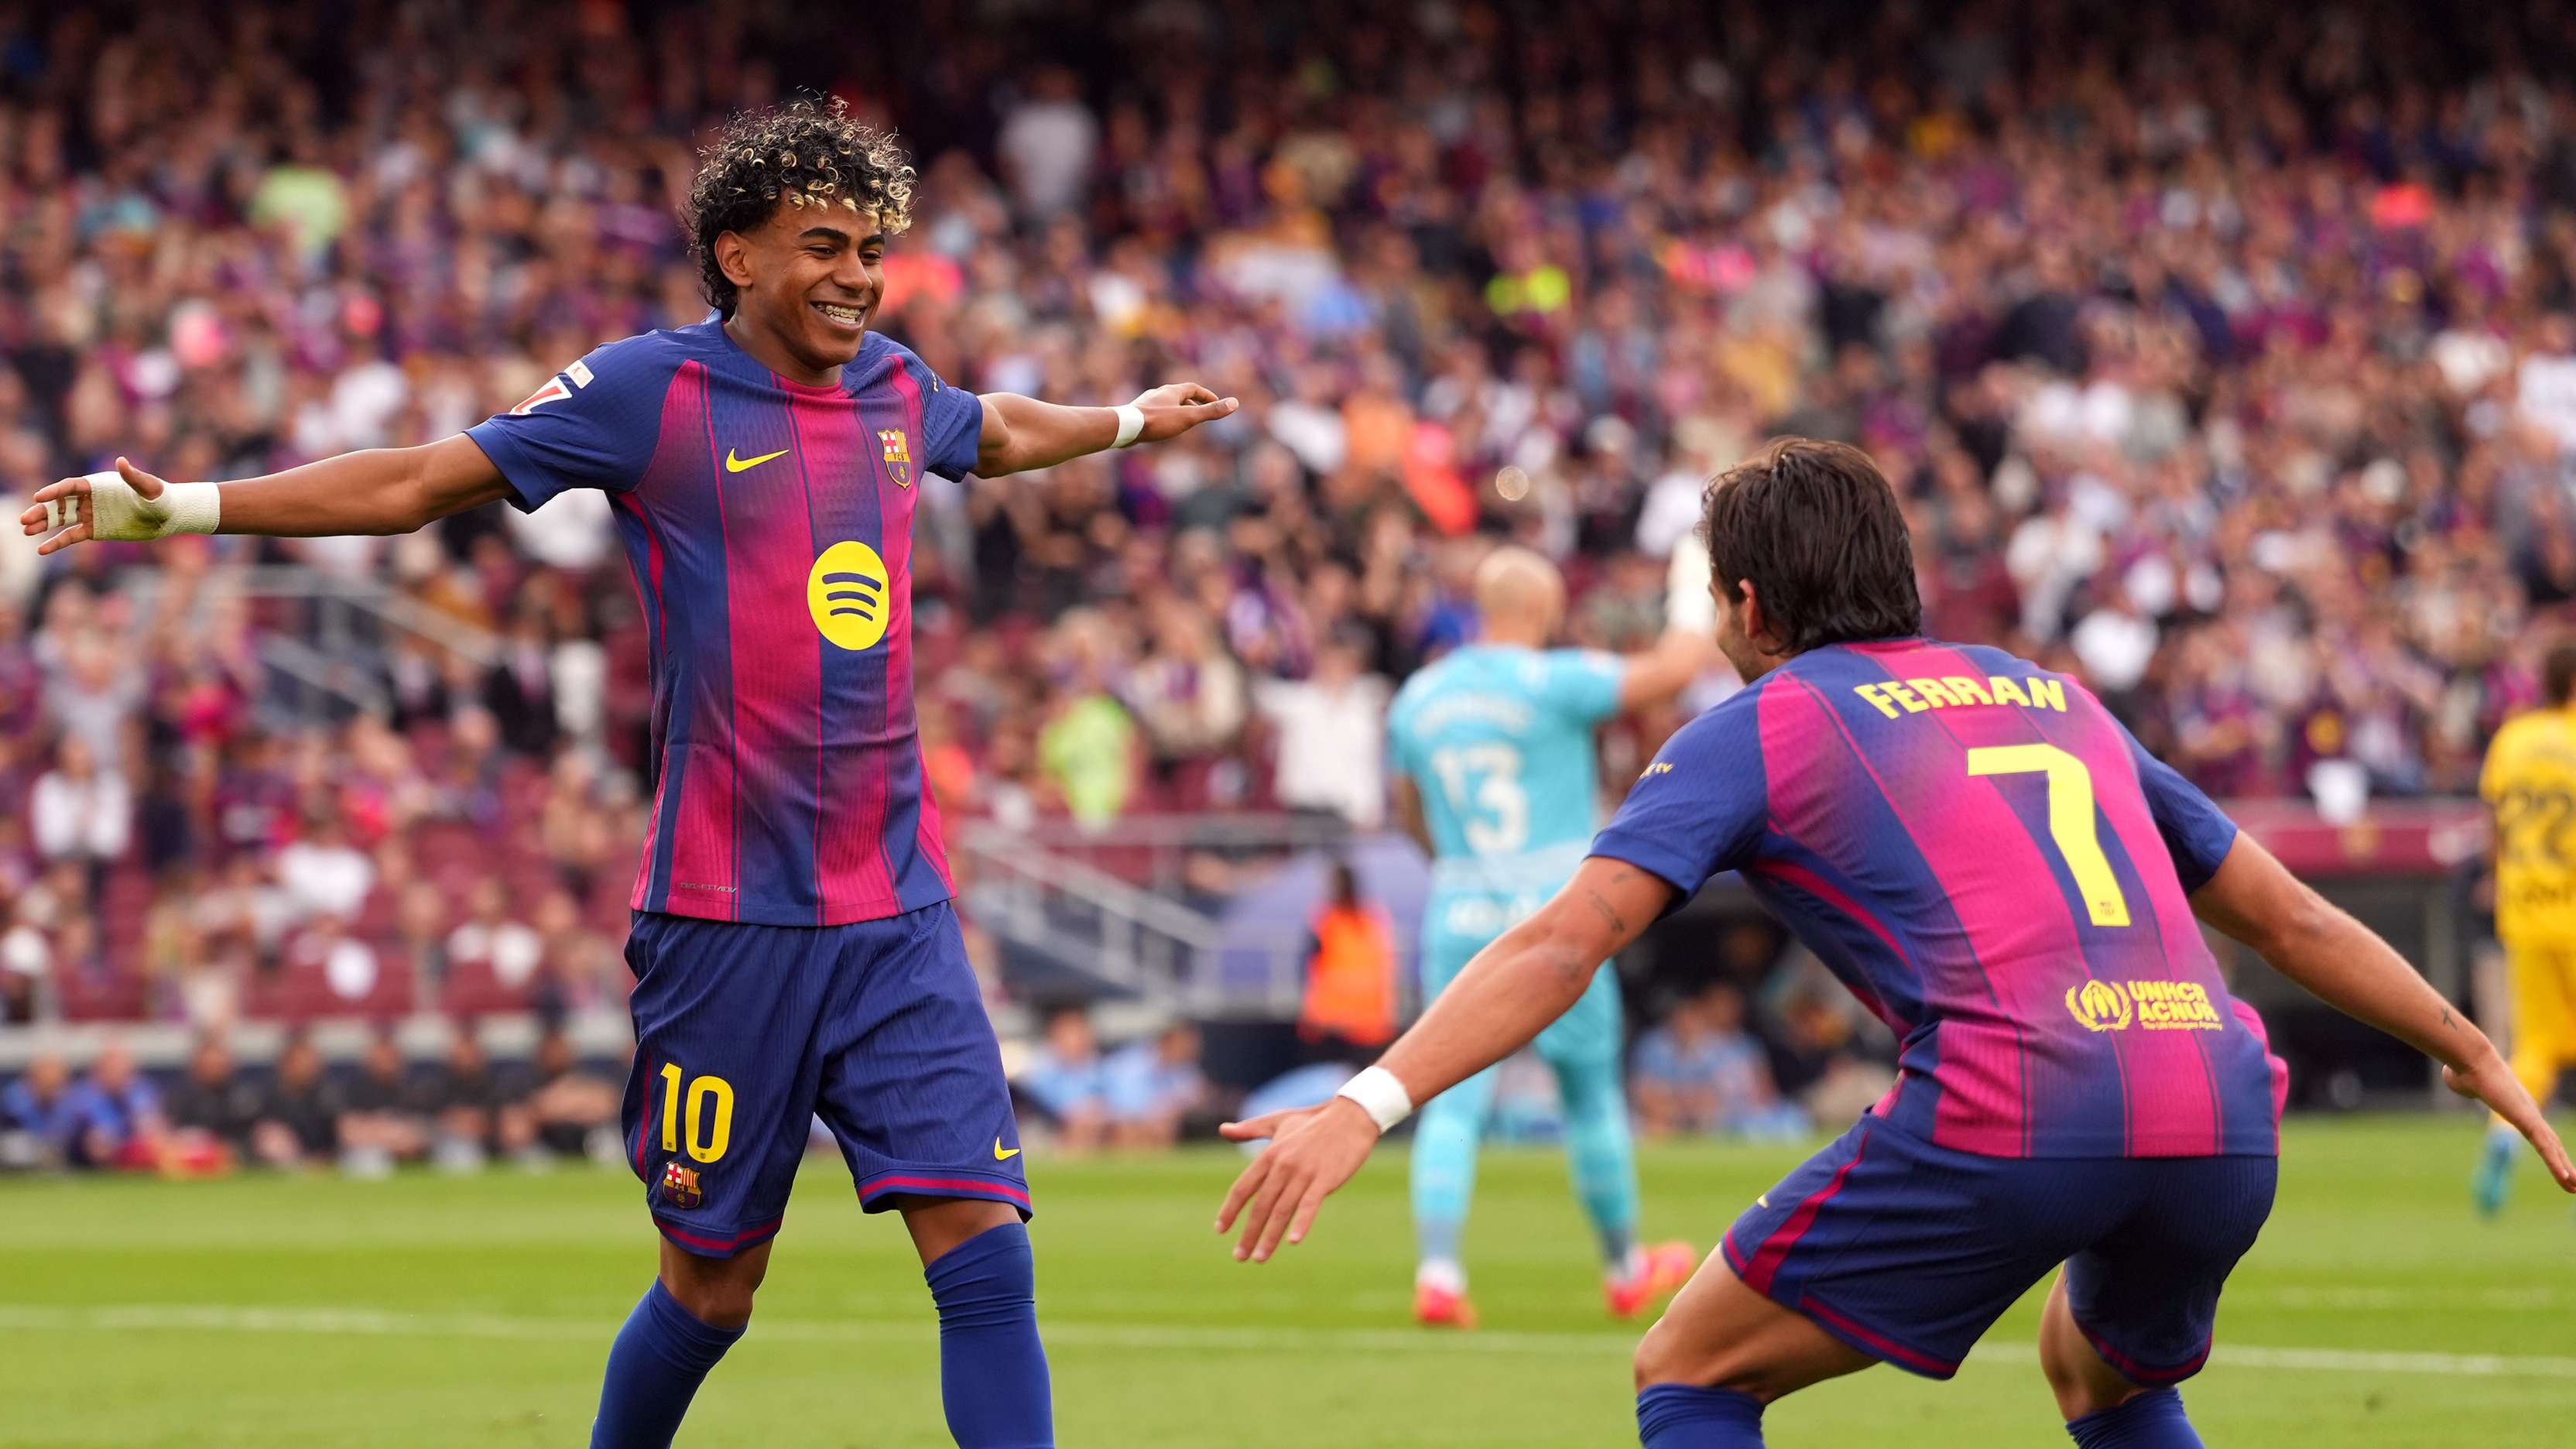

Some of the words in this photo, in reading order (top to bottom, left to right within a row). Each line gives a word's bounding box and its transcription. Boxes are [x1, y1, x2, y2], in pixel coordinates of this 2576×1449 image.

[1854, 676, 2067, 719] FERRAN
[1432, 742, 1530, 855] 13
[1967, 742, 2131, 927] 7
[2127, 980, 2209, 1004] UNHCR
[2138, 1001, 2220, 1022] ACNUR
[659, 1062, 735, 1163] 10
